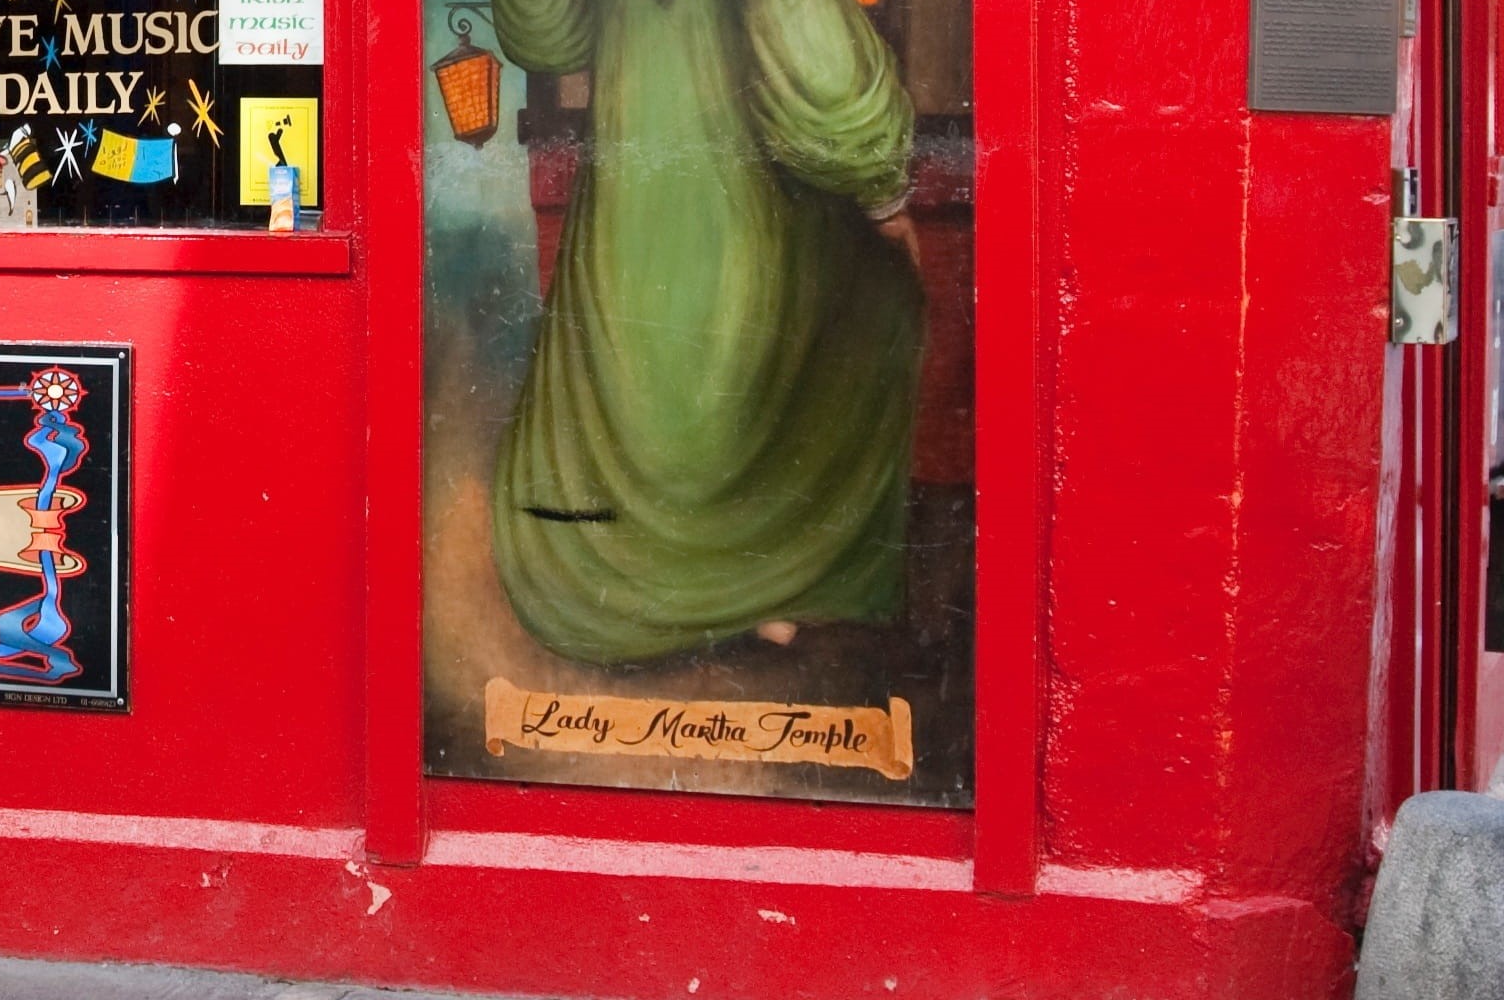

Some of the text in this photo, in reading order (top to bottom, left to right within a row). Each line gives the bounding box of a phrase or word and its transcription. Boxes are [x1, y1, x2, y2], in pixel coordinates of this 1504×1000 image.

[63, 9, 221, 57] MUSIC
[229, 14, 315, 31] music
[4, 692, 68, 705] SIGN DESIGN LTD
[521, 699, 870, 754] Lady Martha Temple
